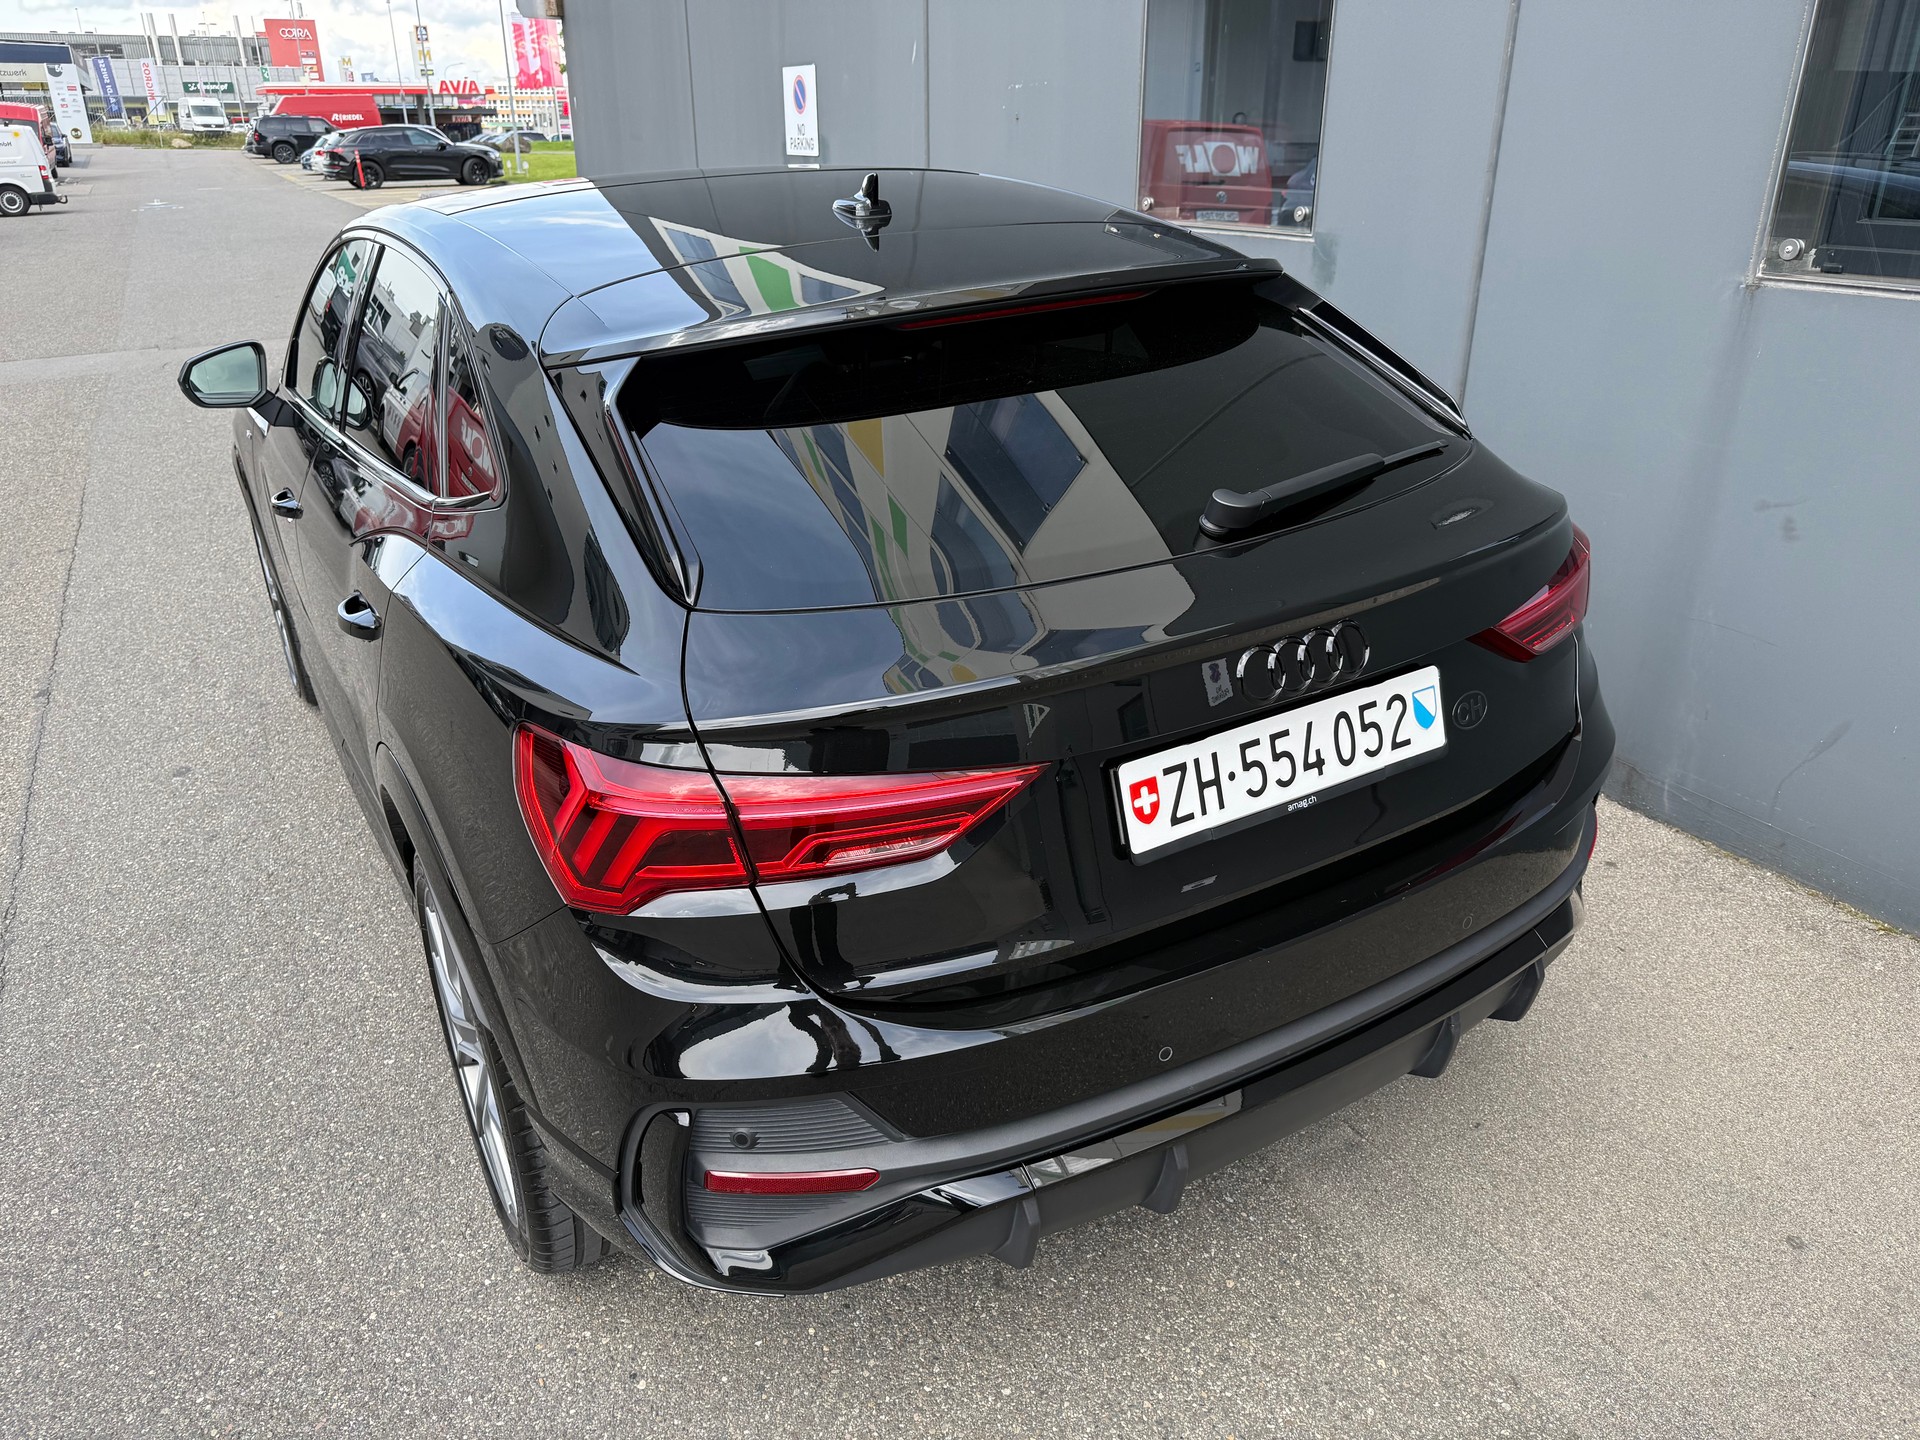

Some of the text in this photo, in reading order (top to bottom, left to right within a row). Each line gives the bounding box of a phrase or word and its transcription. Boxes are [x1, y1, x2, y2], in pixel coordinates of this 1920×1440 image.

[342, 57, 352, 66] M
[418, 49, 432, 62] M
[439, 78, 480, 94] AVIA
[796, 123, 806, 136] NO
[790, 137, 815, 151] PARKING
[1457, 694, 1483, 725] CH
[1287, 795, 1317, 812] amag.ch
